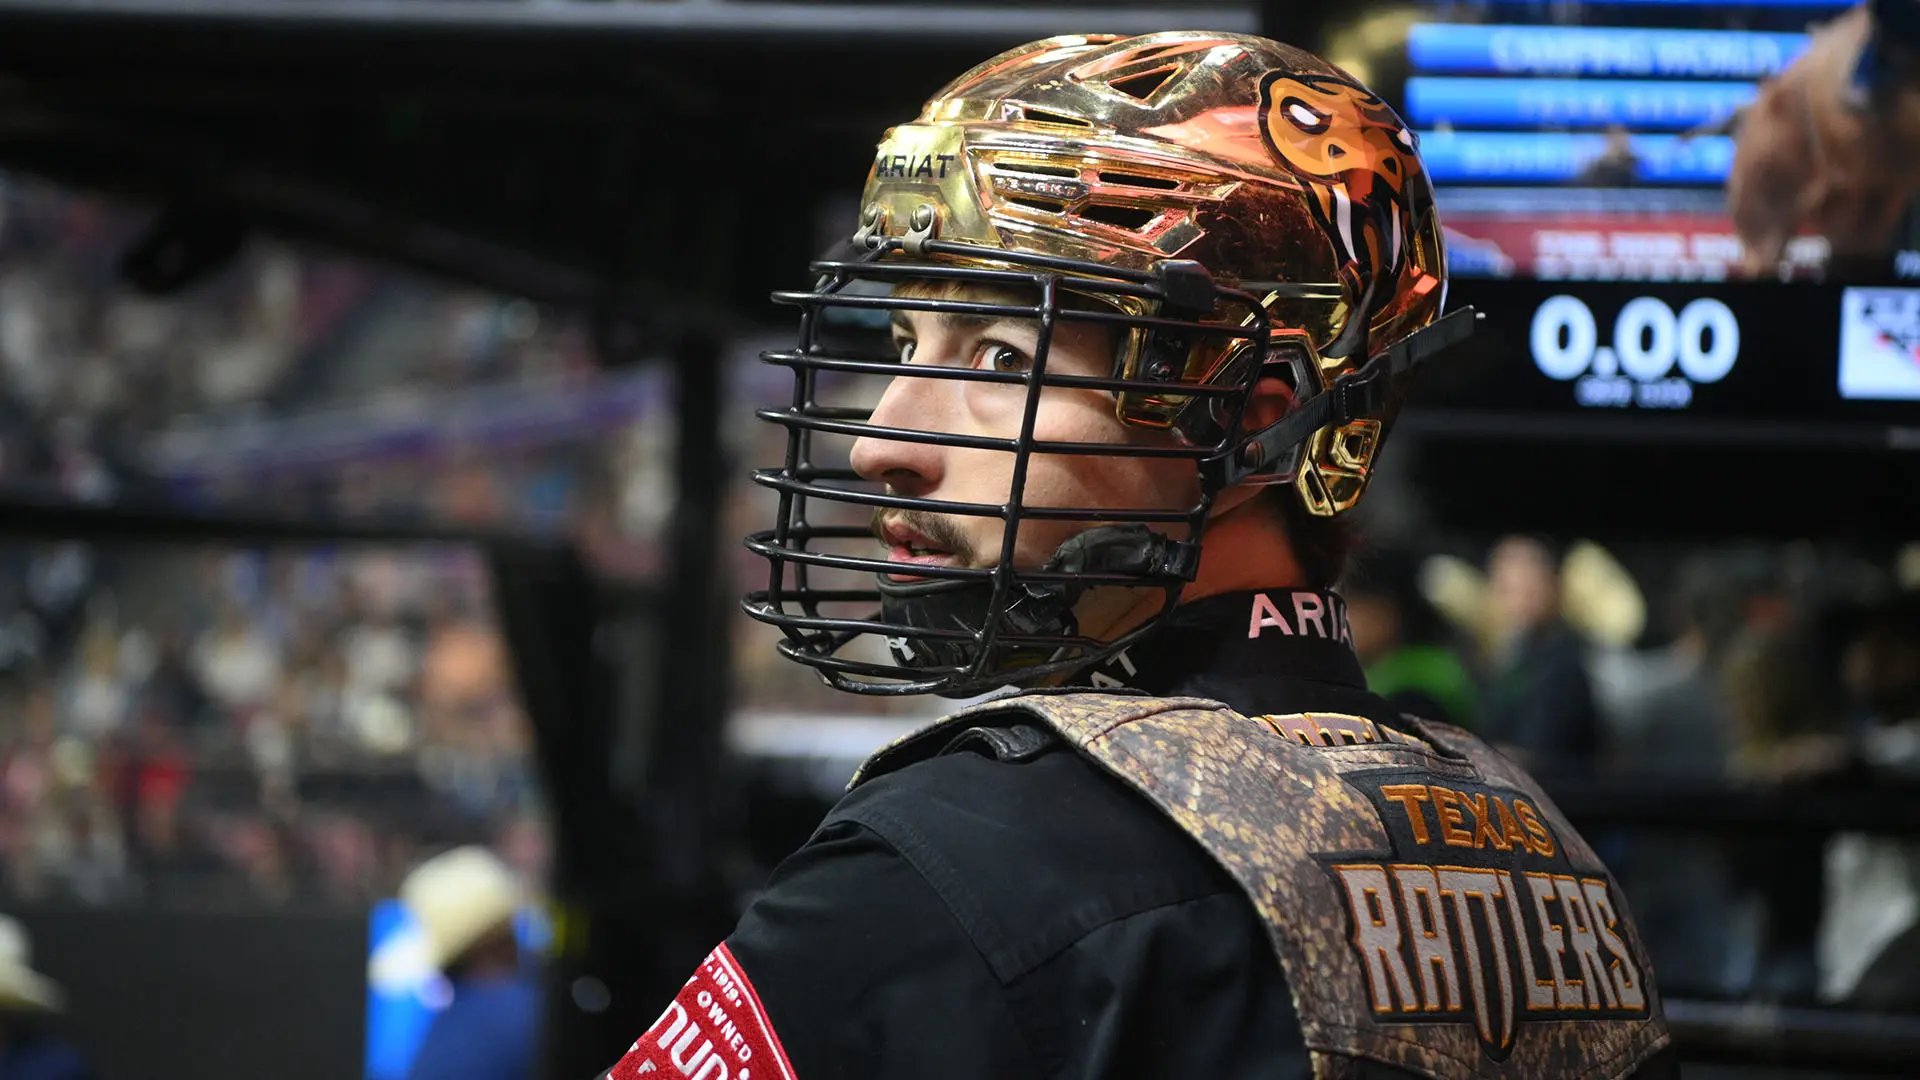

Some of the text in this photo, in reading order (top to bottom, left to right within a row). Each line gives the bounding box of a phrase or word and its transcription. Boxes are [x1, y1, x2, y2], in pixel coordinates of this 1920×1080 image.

[876, 154, 955, 180] ARIAT
[1530, 294, 1740, 384] 0.00
[1380, 784, 1556, 857] TEXAS
[1331, 864, 1647, 1049] RATTLERS
[697, 990, 752, 1062] OWNED
